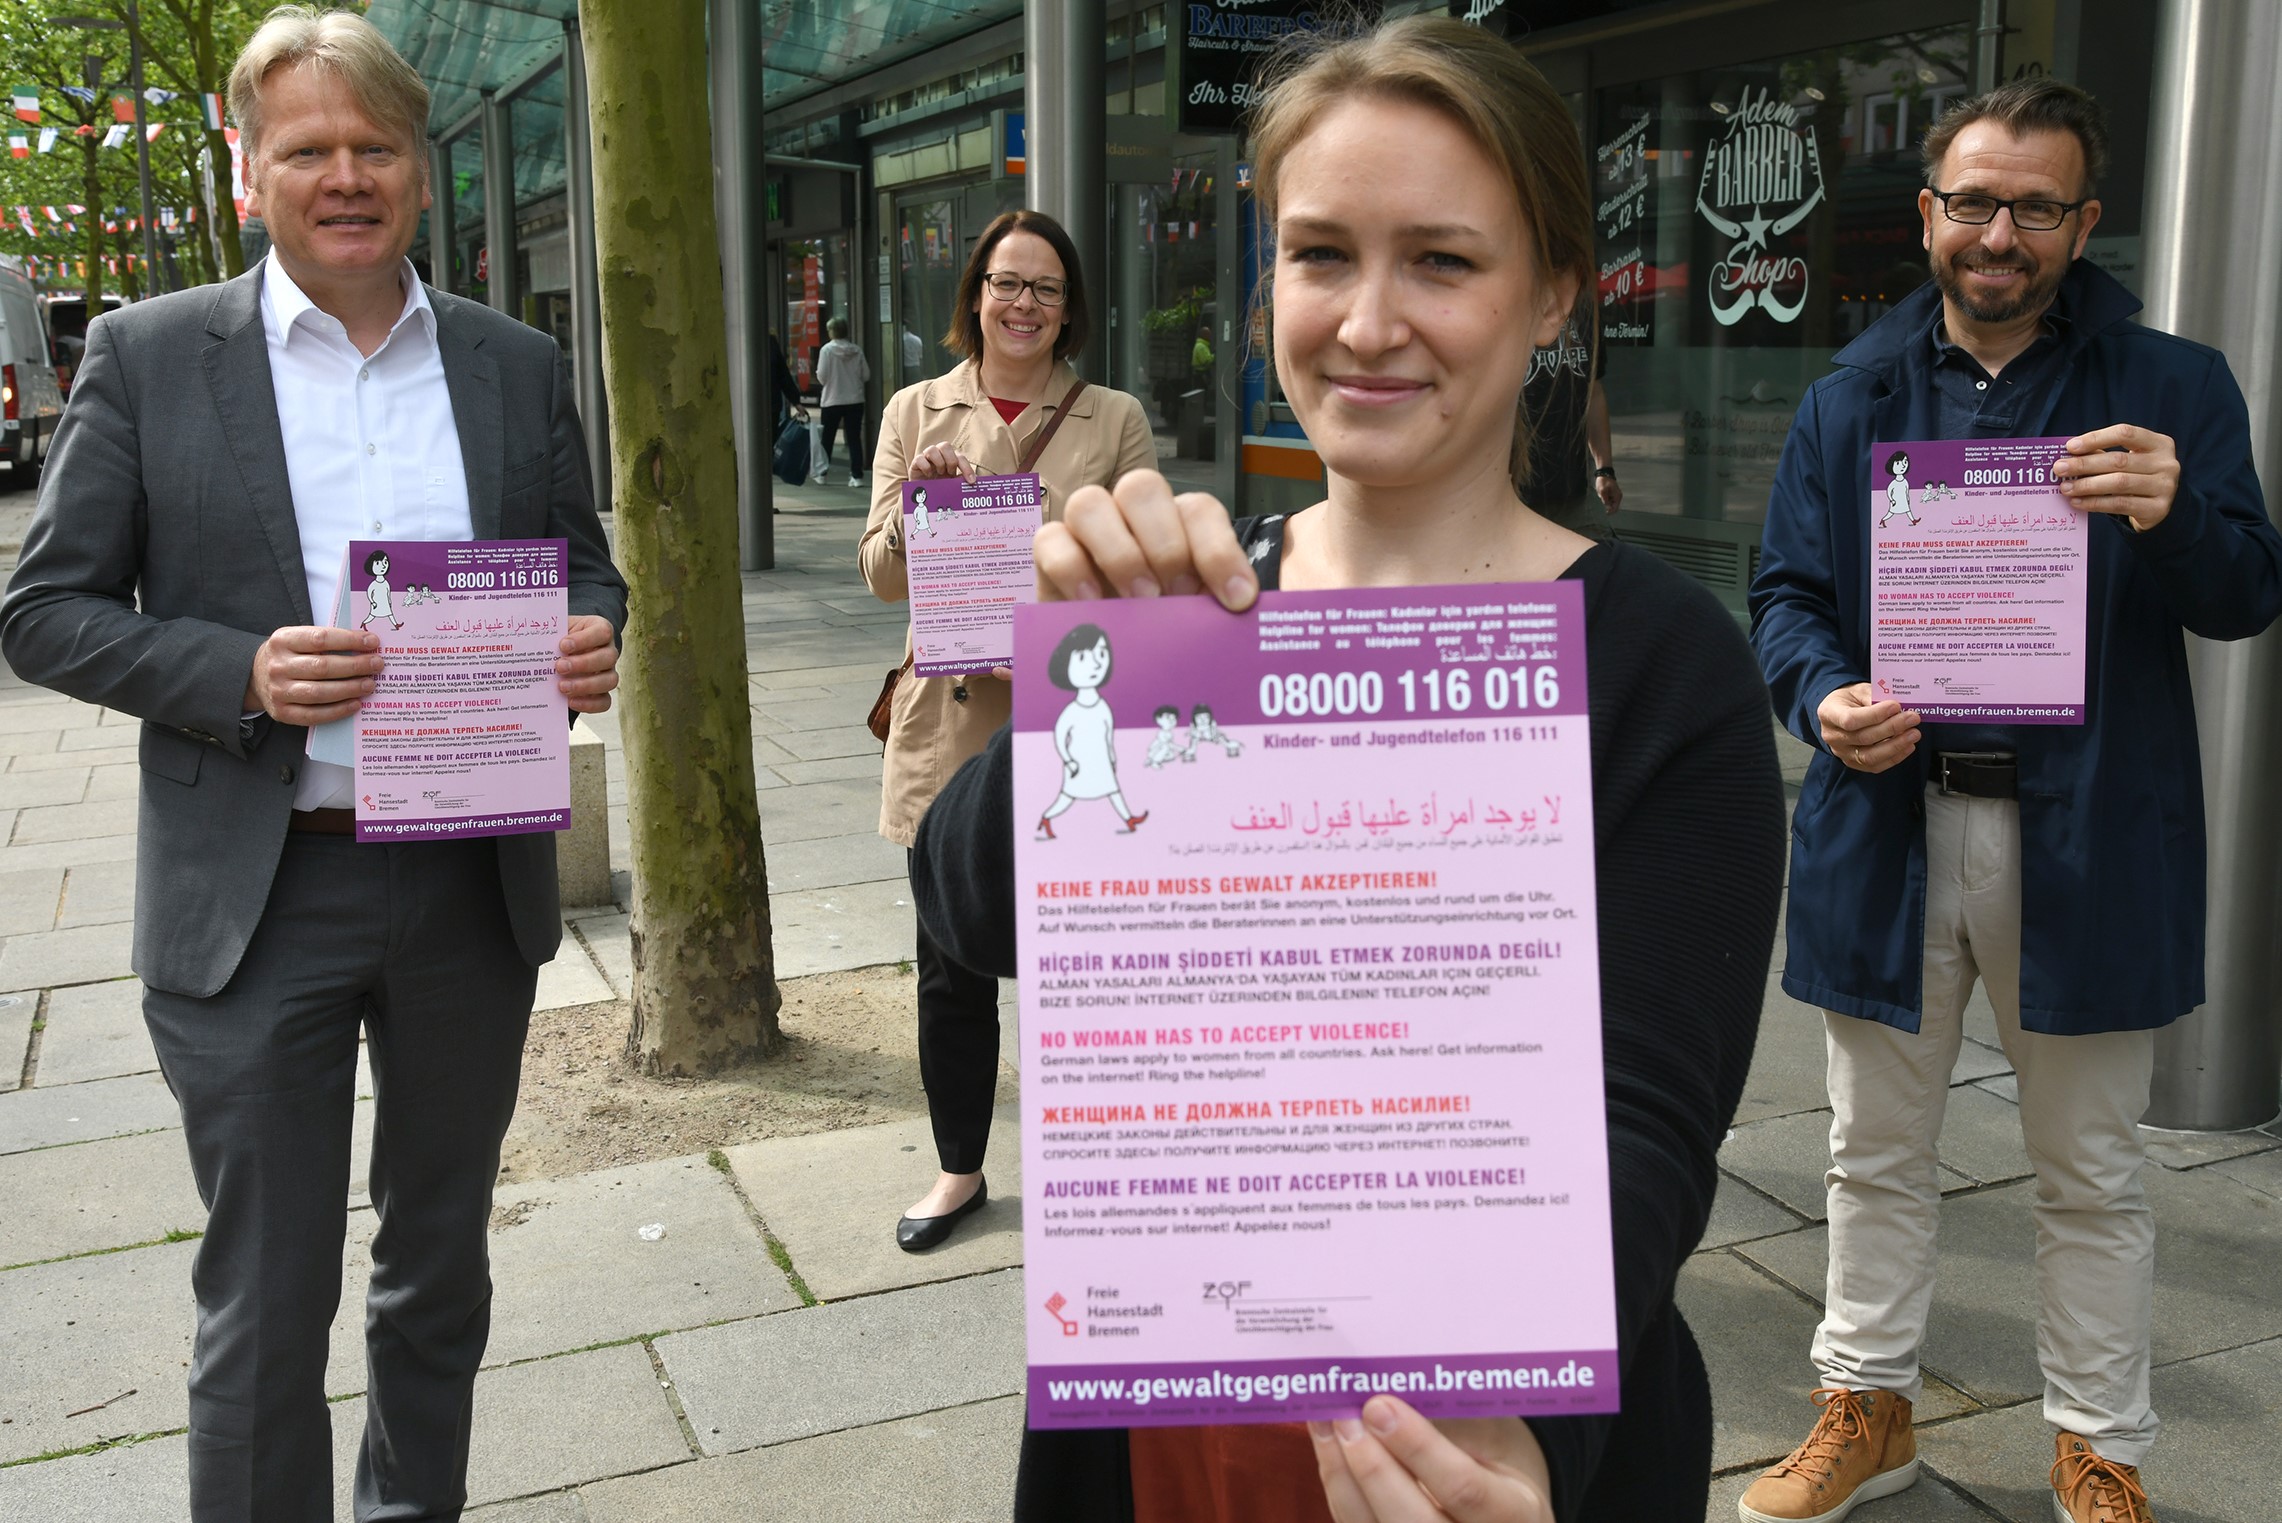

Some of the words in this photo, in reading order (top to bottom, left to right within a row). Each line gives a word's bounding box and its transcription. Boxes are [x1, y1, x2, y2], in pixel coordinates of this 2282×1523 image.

[1187, 4, 1362, 39] BARBERS
[1187, 37, 1230, 50] Haircuts
[1231, 40, 1240, 50] &
[1188, 80, 1228, 105] Ihr
[1231, 83, 1268, 108] He
[1723, 84, 1800, 140] Adem
[1597, 112, 1650, 163] Herrenschnitt
[1608, 168, 1618, 181] ab
[1620, 144, 1633, 171] 13
[1636, 132, 1646, 157] €
[1717, 123, 1804, 208] BARBER
[1597, 173, 1649, 221] Kinderschnitt
[1607, 225, 1618, 240] ab
[1618, 203, 1632, 231] 12
[1635, 194, 1645, 218] €
[1600, 247, 1642, 281] Bartrasur
[1720, 240, 1788, 291] Shop
[1604, 292, 1615, 306] ab
[1615, 271, 1630, 298] 10
[1634, 261, 1644, 286] €
[1618, 323, 1650, 338] Termin!
[1964, 468, 2011, 486] 08000
[2016, 467, 2045, 484] 116
[962, 495, 992, 509] 08000
[995, 494, 1014, 507] 116
[1016, 492, 1035, 505] 016
[1878, 541, 1900, 549] KEINE
[1922, 540, 1944, 548] MUSS
[1945, 540, 1975, 548] GEWALT
[1976, 539, 2028, 547] AKZEPTIEREN!
[447, 571, 495, 589] 08000
[499, 570, 527, 588] 116
[531, 569, 559, 586] 016
[919, 659, 1013, 672] www.gewaltgegenfrauen.b
[1259, 670, 1384, 717] 08000
[1397, 668, 1472, 712] 116
[1484, 665, 1560, 710] 016
[1263, 733, 1324, 749] Kinder-
[1329, 731, 1361, 748] und
[1367, 728, 1486, 749] Jugendtelefon
[1492, 727, 1523, 742] 116
[1529, 726, 1558, 741] 111
[363, 812, 563, 835] www.gewaltgegenfrauen.bremen.de
[1231, 801, 1293, 832] العنف
[1302, 800, 1352, 839] قبول
[1358, 798, 1411, 836] عليها
[1420, 793, 1474, 835] امرأة
[1484, 805, 1536, 832] يوجد
[1543, 795, 1561, 825] لا
[1036, 880, 1092, 899] KEINE
[1100, 879, 1150, 897] FRAU
[1157, 877, 1212, 896] MUSS
[1219, 875, 1294, 894] GEWALT
[1300, 871, 1437, 891] AKZEPTIEREN!
[1037, 904, 1064, 917] Das
[1067, 903, 1145, 915] Hilfetelefon
[1148, 901, 1167, 914] für
[1170, 900, 1218, 913] Frauen
[1220, 899, 1256, 912] berät
[1259, 898, 1281, 911] Sie
[1285, 899, 1342, 911] anonym,
[1345, 895, 1412, 908] kostenlos
[1414, 894, 1441, 906] und
[1443, 893, 1476, 906] rund
[1478, 894, 1501, 904] um
[1503, 892, 1525, 904] die
[1528, 891, 1555, 903] Uhr.
[1037, 922, 1060, 934] Auf
[1063, 921, 1117, 933] Wunsch
[1119, 920, 1186, 932] vermitteln
[1187, 918, 1209, 930] die
[1211, 917, 1297, 930] Beraterinnen
[1299, 917, 1317, 927] an
[1319, 916, 1347, 926] eine
[1350, 910, 1525, 926] Unterstützungseinrichtung
[1528, 910, 1549, 920] vor
[1552, 907, 1577, 920] Ort.
[1039, 952, 1104, 976] HİÇBİR
[1111, 953, 1170, 971] KADIN
[1178, 948, 1252, 974] ŞİDDETİ
[1260, 949, 1323, 967] KABUL
[1330, 947, 1394, 965] ETMEK
[1402, 944, 1492, 963] ZORUNDA
[1040, 1031, 1067, 1049] NO
[1073, 1029, 1147, 1048] WOMAN
[1155, 1027, 1193, 1045] HAS
[1199, 1027, 1224, 1044] TO
[1230, 1024, 1302, 1043] ACCEPT
[1309, 1022, 1409, 1041] VIOLENCE!
[1040, 1054, 1095, 1067] German
[1097, 1054, 1130, 1065] laws
[1133, 1052, 1170, 1066] apply
[1172, 1052, 1188, 1063] to
[1190, 1052, 1241, 1063] women
[1243, 1049, 1276, 1061] from
[1279, 1048, 1296, 1061] all
[1298, 1048, 1365, 1060] countries.
[1370, 1046, 1396, 1058] Ask
[1399, 1045, 1434, 1057] here!
[1437, 1043, 1462, 1057] Get
[1464, 1042, 1544, 1055] information
[1040, 1075, 1059, 1085] on
[1062, 1072, 1084, 1084] the
[1087, 1070, 1145, 1083] internet!
[1148, 1069, 1180, 1084] Ring
[1183, 1069, 1205, 1081] the
[1208, 1067, 1266, 1081] helpline!
[1042, 1105, 1146, 1125] ЖЕНЩИНА
[1153, 1103, 1178, 1121] НЕ
[1185, 1101, 1272, 1123] ДОЛЖНА
[1279, 1099, 1364, 1118] ТЕРПЕТЬ
[1371, 1095, 1470, 1115] НАСИЛИЕ!
[1043, 1179, 1120, 1199] AUCUNE
[1128, 1177, 1197, 1196] FEMME
[1205, 1176, 1230, 1194] NE
[1238, 1175, 1282, 1193] DOIT
[1289, 1172, 1388, 1192] ACCEPTER
[1395, 1171, 1419, 1189] LA
[1425, 1168, 1525, 1188] VIOLENCE!
[1044, 1207, 1069, 1220] Les
[1072, 1208, 1097, 1219] lois
[1100, 1205, 1178, 1218] allemandes
[1269, 1204, 1294, 1214] aux
[1297, 1201, 1353, 1213] femmes
[1355, 1200, 1373, 1211] de
[1376, 1199, 1407, 1211] tous
[1410, 1198, 1431, 1210] les
[1433, 1198, 1469, 1211] pays.
[1473, 1194, 1546, 1208] Demandez
[1549, 1193, 1570, 1205] ici!
[1044, 1225, 1144, 1238] Informez-vous
[1146, 1225, 1168, 1235] sur
[1172, 1221, 1230, 1235] internet!
[1233, 1220, 1288, 1235] Appelez
[1292, 1218, 1331, 1231] nous!
[1086, 1286, 1120, 1300] Freie
[1087, 1303, 1163, 1319] Hansestadt
[1087, 1324, 1140, 1338] Bremen
[1048, 1359, 1595, 1405] www.gewaltgegenfrauen.bremen.de
